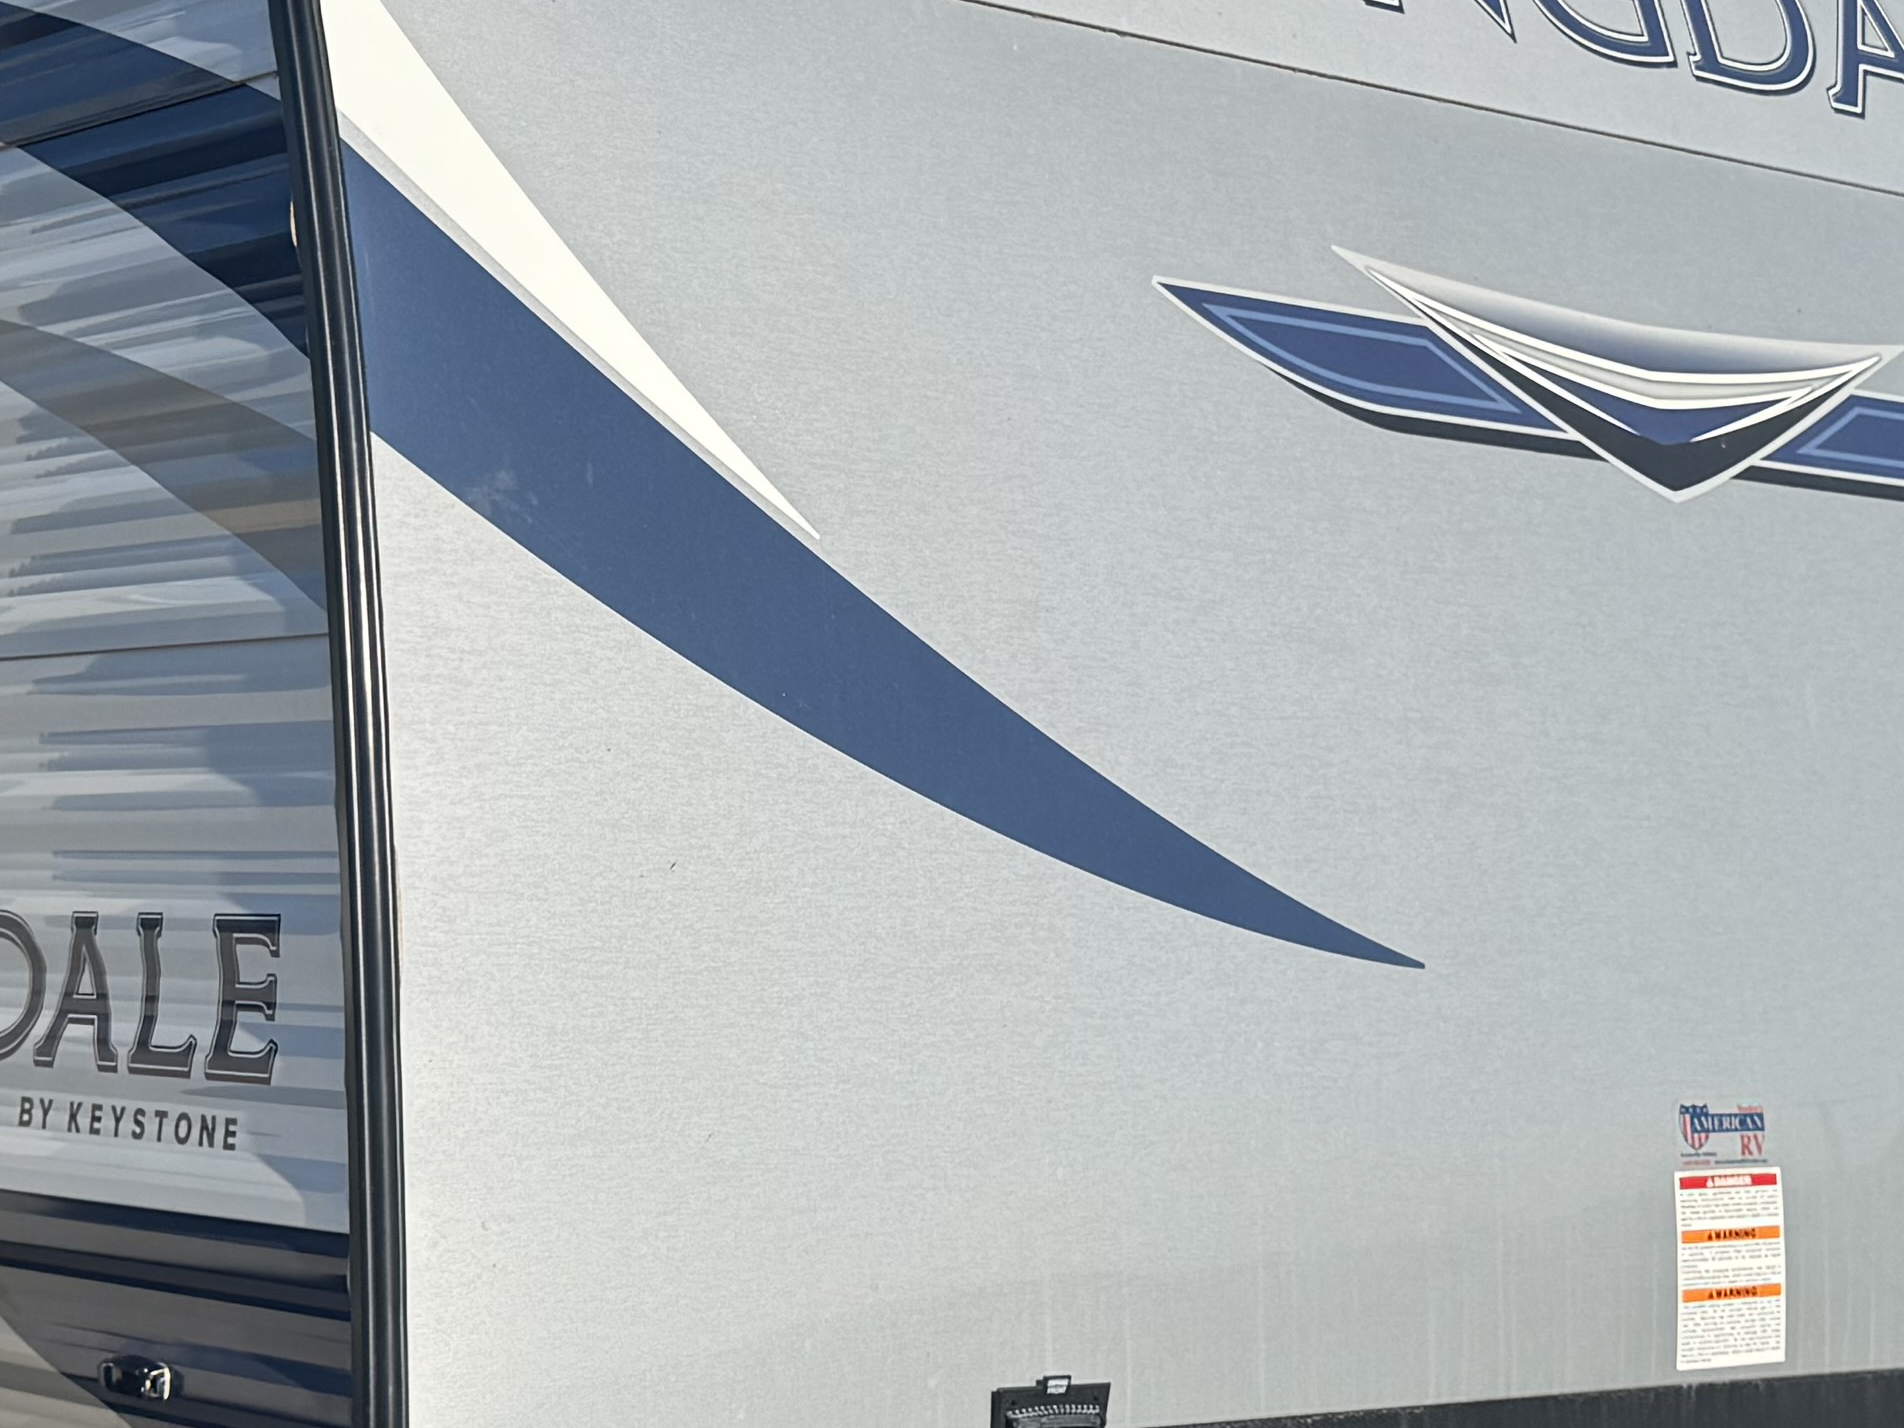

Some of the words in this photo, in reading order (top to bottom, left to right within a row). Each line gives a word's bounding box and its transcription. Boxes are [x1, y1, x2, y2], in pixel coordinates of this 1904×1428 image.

[18, 1095, 51, 1131] BY
[66, 1101, 239, 1152] KEYSTONE
[1692, 1114, 1763, 1132] AMERICAN
[1739, 1133, 1765, 1157] RV
